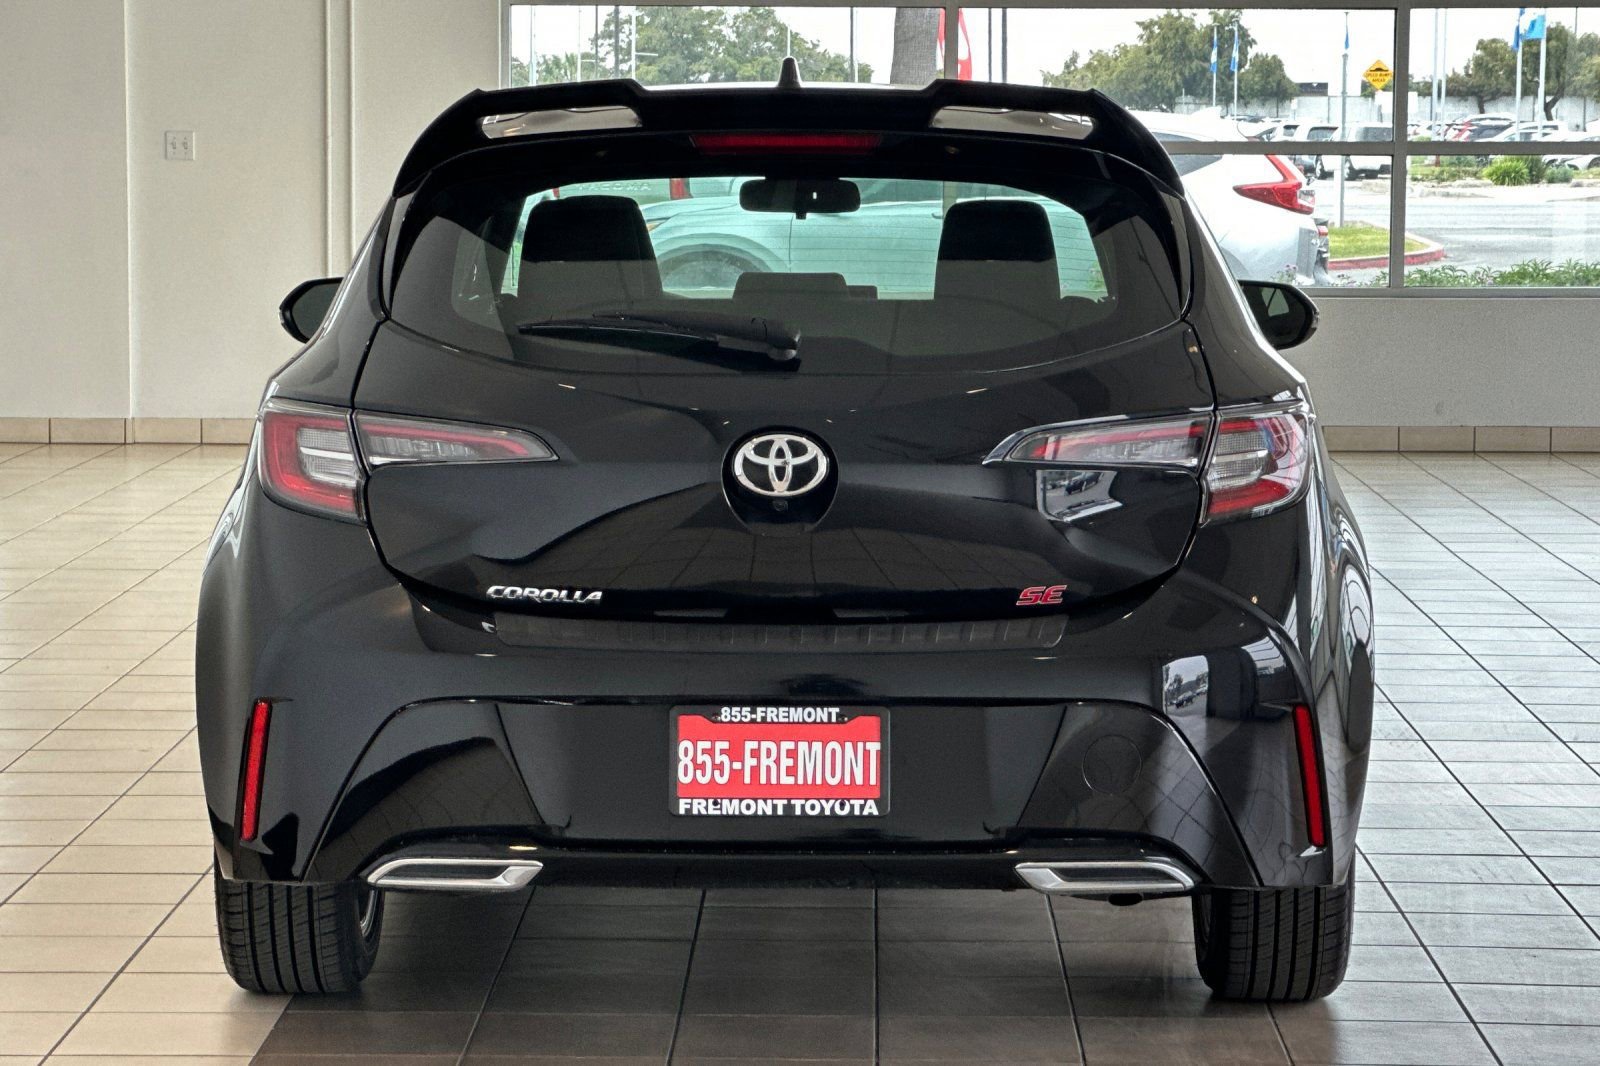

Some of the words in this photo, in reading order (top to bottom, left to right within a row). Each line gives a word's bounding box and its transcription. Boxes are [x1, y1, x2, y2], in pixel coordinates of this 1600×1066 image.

[486, 585, 603, 603] COROLLA
[1016, 584, 1068, 605] SE
[720, 707, 840, 723] 855-FREMONT
[678, 740, 881, 785] 855-FREMONT
[679, 798, 787, 815] FREMONT
[791, 798, 879, 815] TOYOTA
